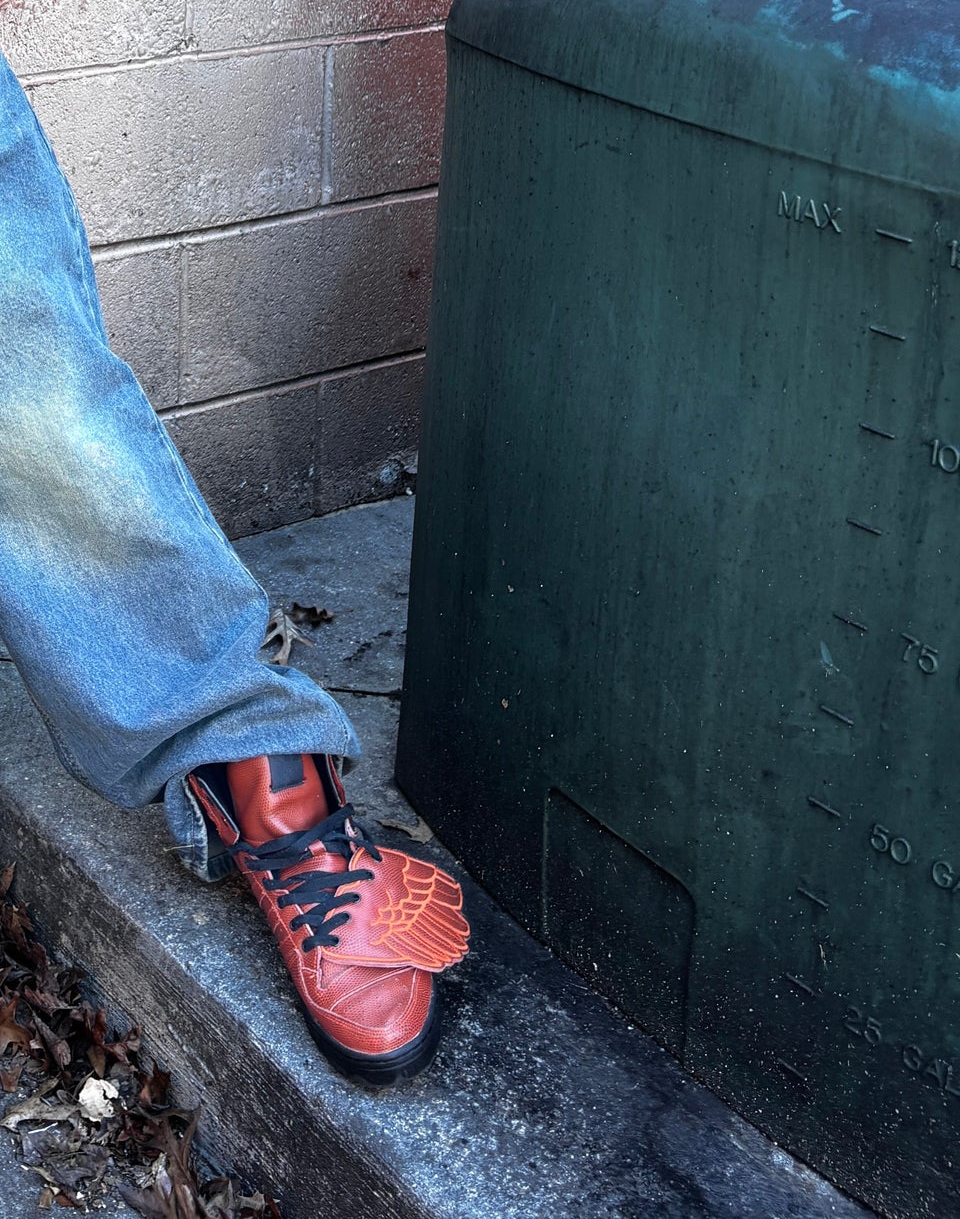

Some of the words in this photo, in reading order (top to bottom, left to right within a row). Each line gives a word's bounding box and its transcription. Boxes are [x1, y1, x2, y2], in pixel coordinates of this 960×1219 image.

[777, 190, 842, 233] MAX
[899, 631, 939, 675] 75
[870, 823, 911, 865] 50
[932, 860, 960, 893] G
[844, 1005, 882, 1045] 25
